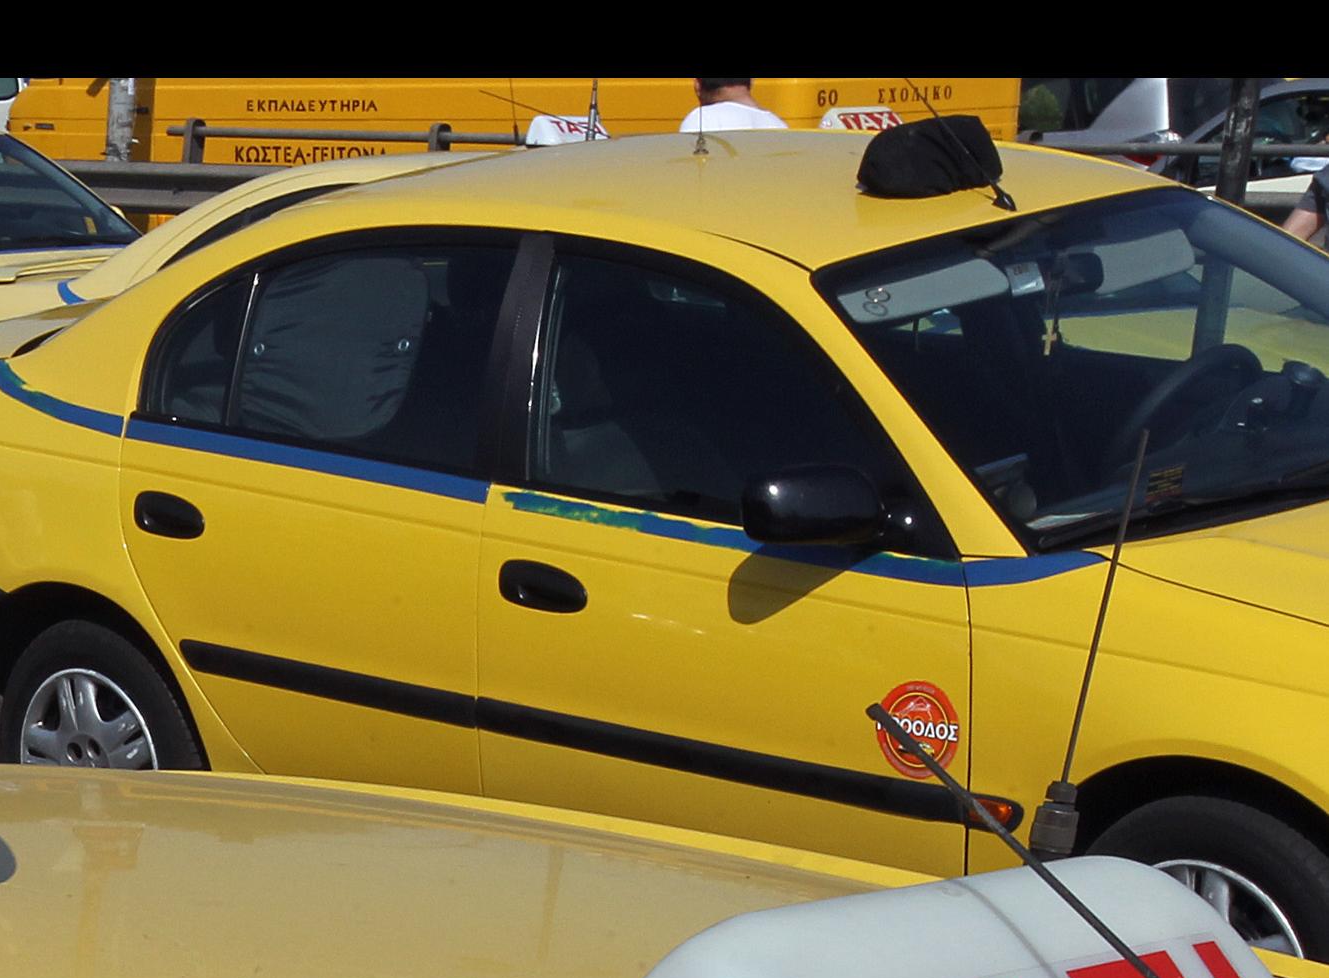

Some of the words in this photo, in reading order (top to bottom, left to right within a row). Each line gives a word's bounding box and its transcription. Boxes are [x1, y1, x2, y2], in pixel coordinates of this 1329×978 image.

[817, 89, 838, 107] 60
[878, 85, 953, 104] ΣΧΟΛΙΚΟ
[246, 99, 378, 112] ΕΚΠΑΙΔΕΥΤΗΡΙΑ
[877, 716, 959, 742] ΟΟΔΟΣ
